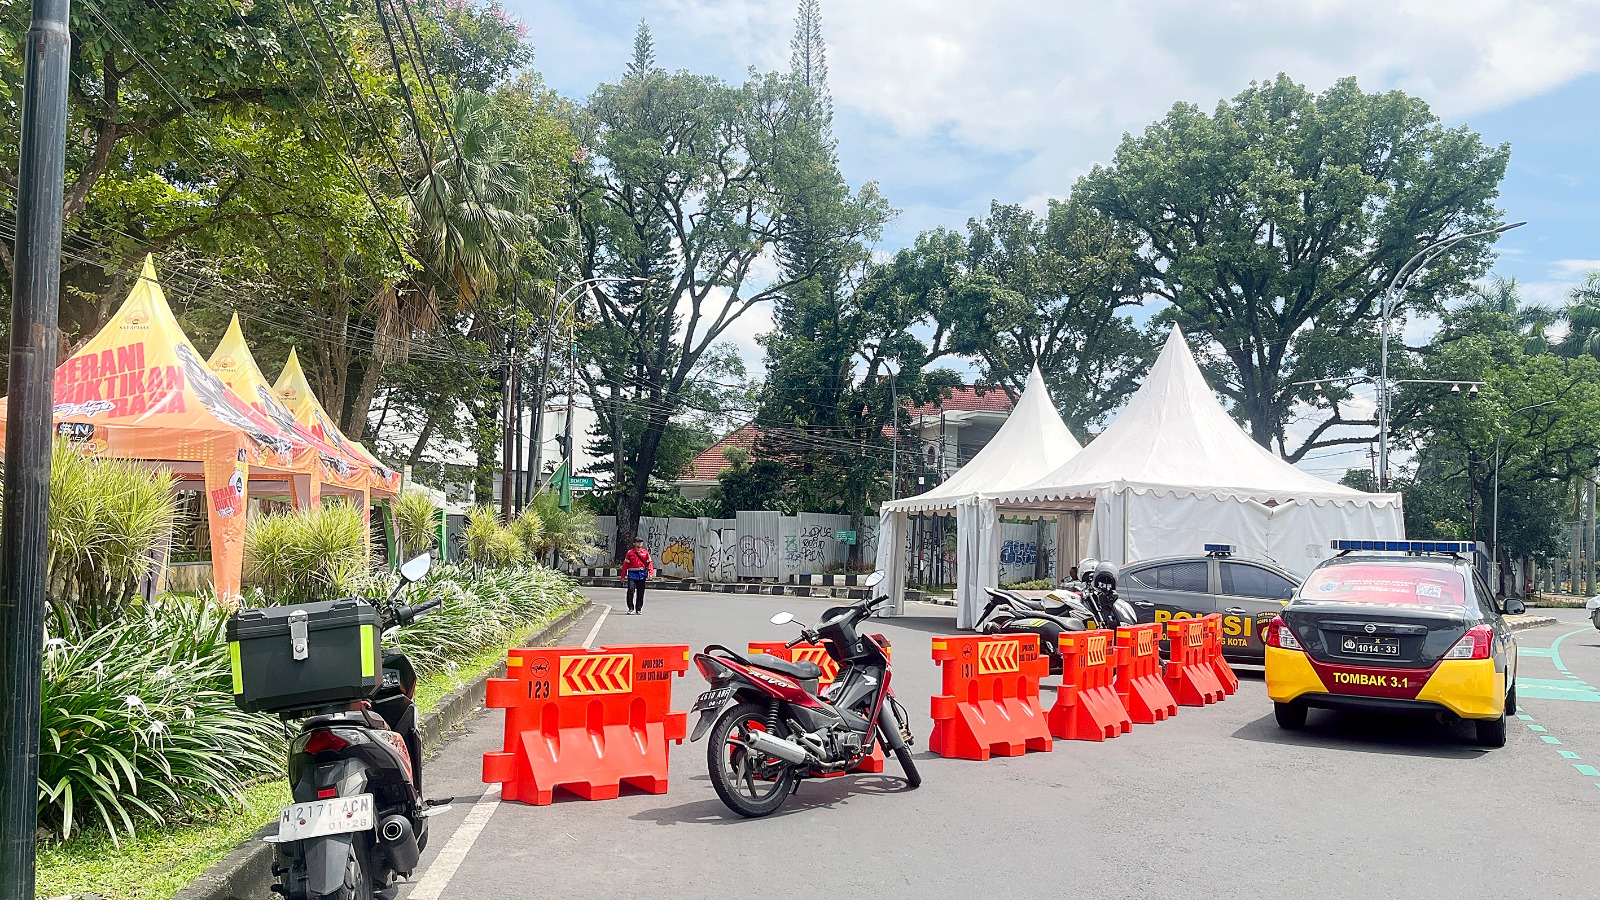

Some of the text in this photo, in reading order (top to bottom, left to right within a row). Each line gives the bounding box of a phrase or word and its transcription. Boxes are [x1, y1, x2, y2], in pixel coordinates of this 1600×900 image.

[1227, 637, 1248, 647] KOTA
[1332, 672, 1409, 688] TOMBAK 3.1
[528, 681, 550, 699] 123
[296, 803, 333, 820] 2171
